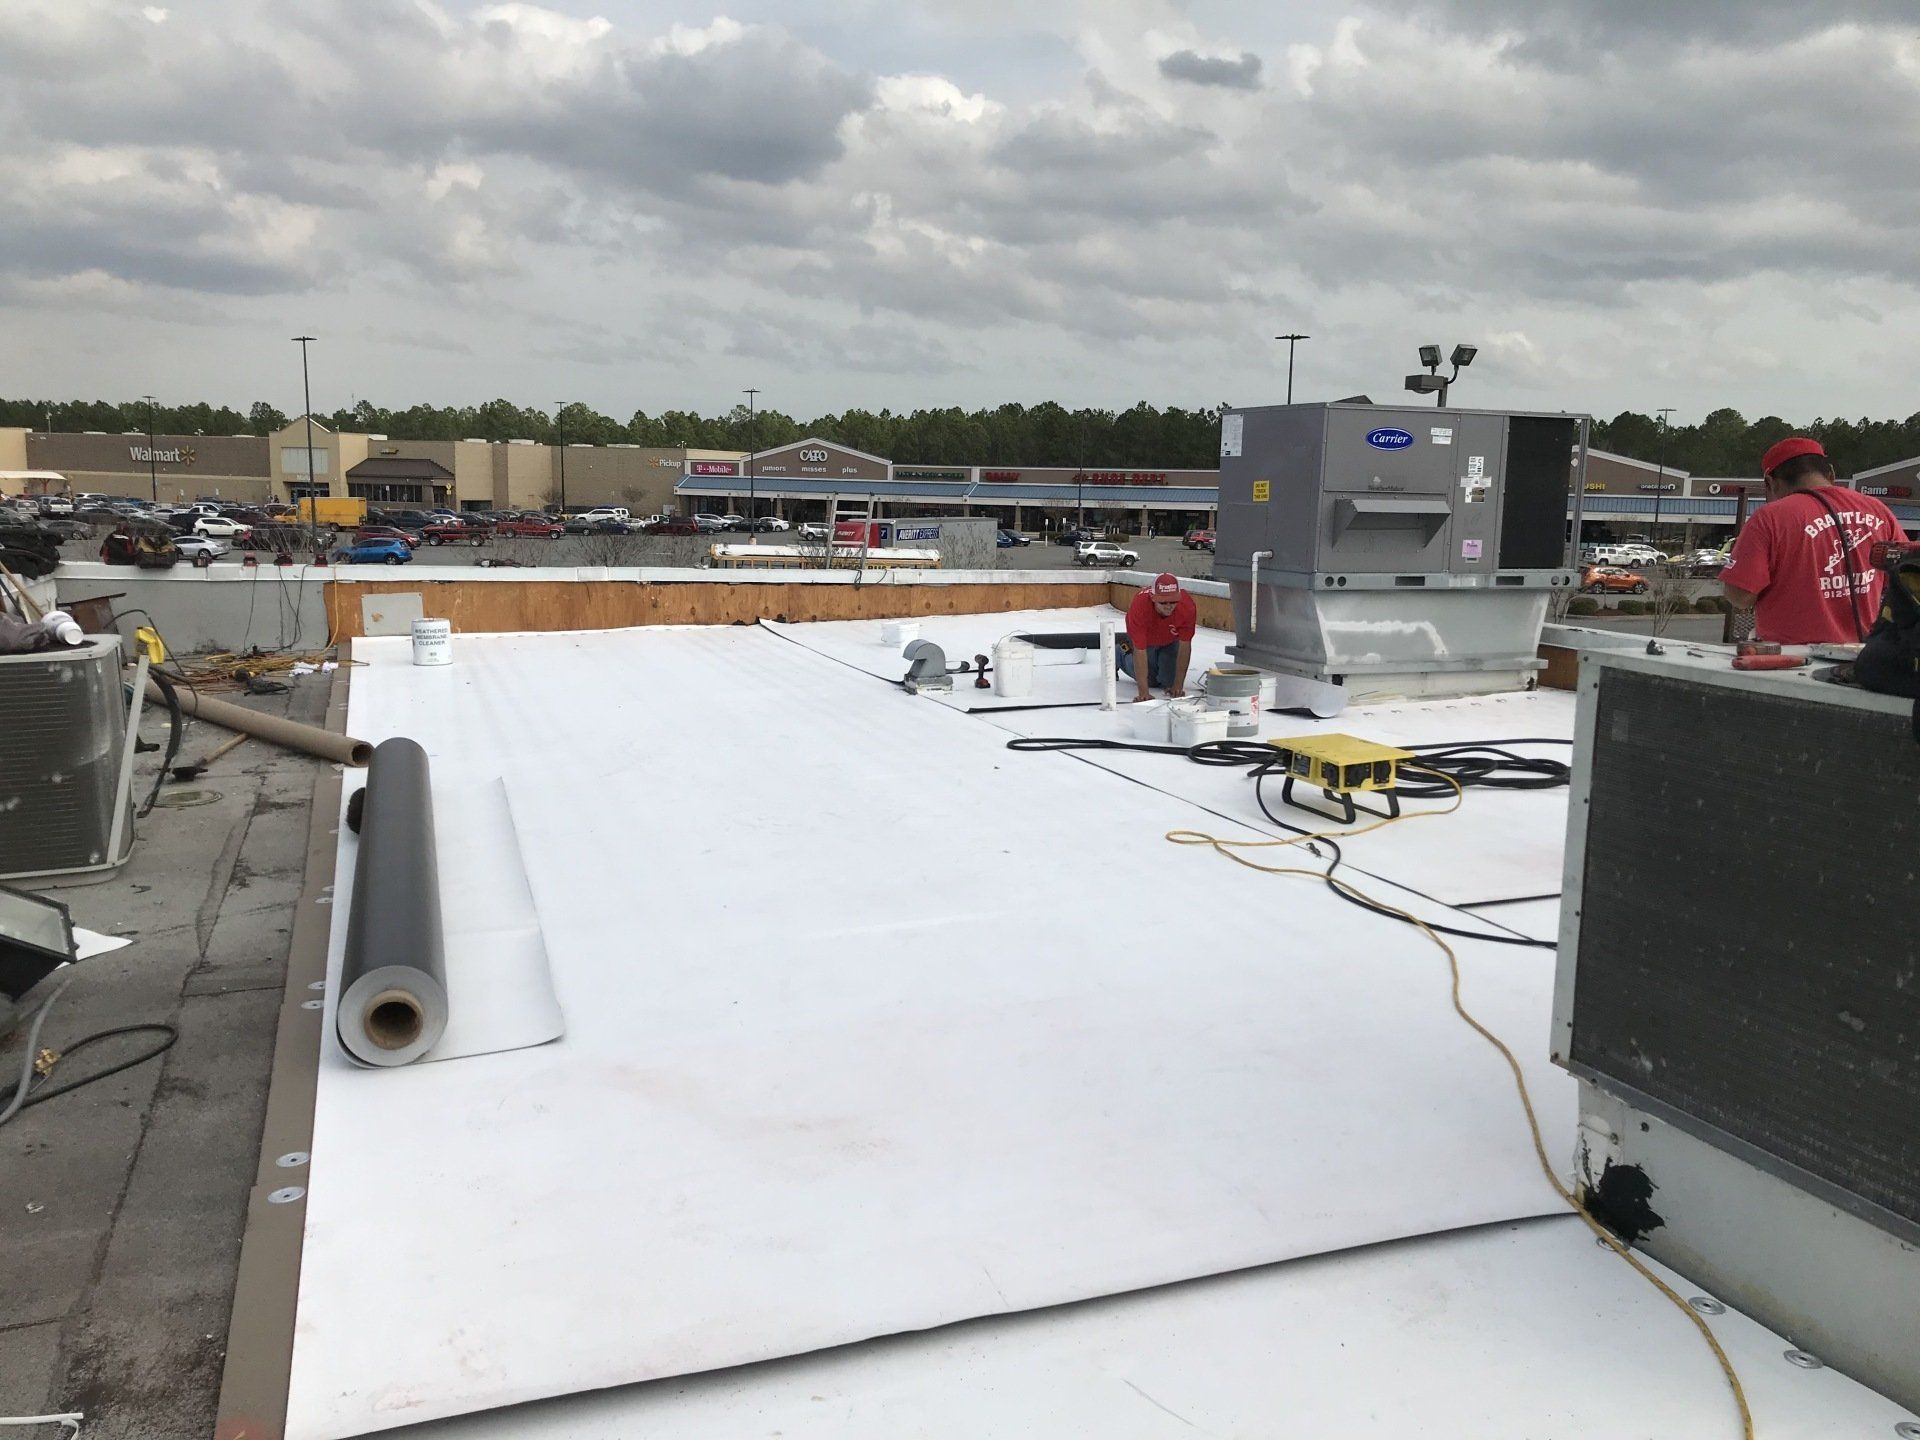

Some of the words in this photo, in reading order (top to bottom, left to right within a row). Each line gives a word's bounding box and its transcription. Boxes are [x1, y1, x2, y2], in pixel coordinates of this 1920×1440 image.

[1372, 433, 1408, 443] Carrier
[129, 446, 180, 462] Walmart
[800, 449, 828, 461] CATO
[660, 459, 682, 469] Pickup
[762, 465, 787, 473] juniors
[842, 466, 858, 474] plus
[898, 529, 919, 540] AVERITT
[919, 529, 938, 539] EXPRESS
[1820, 569, 1876, 590] ROING
